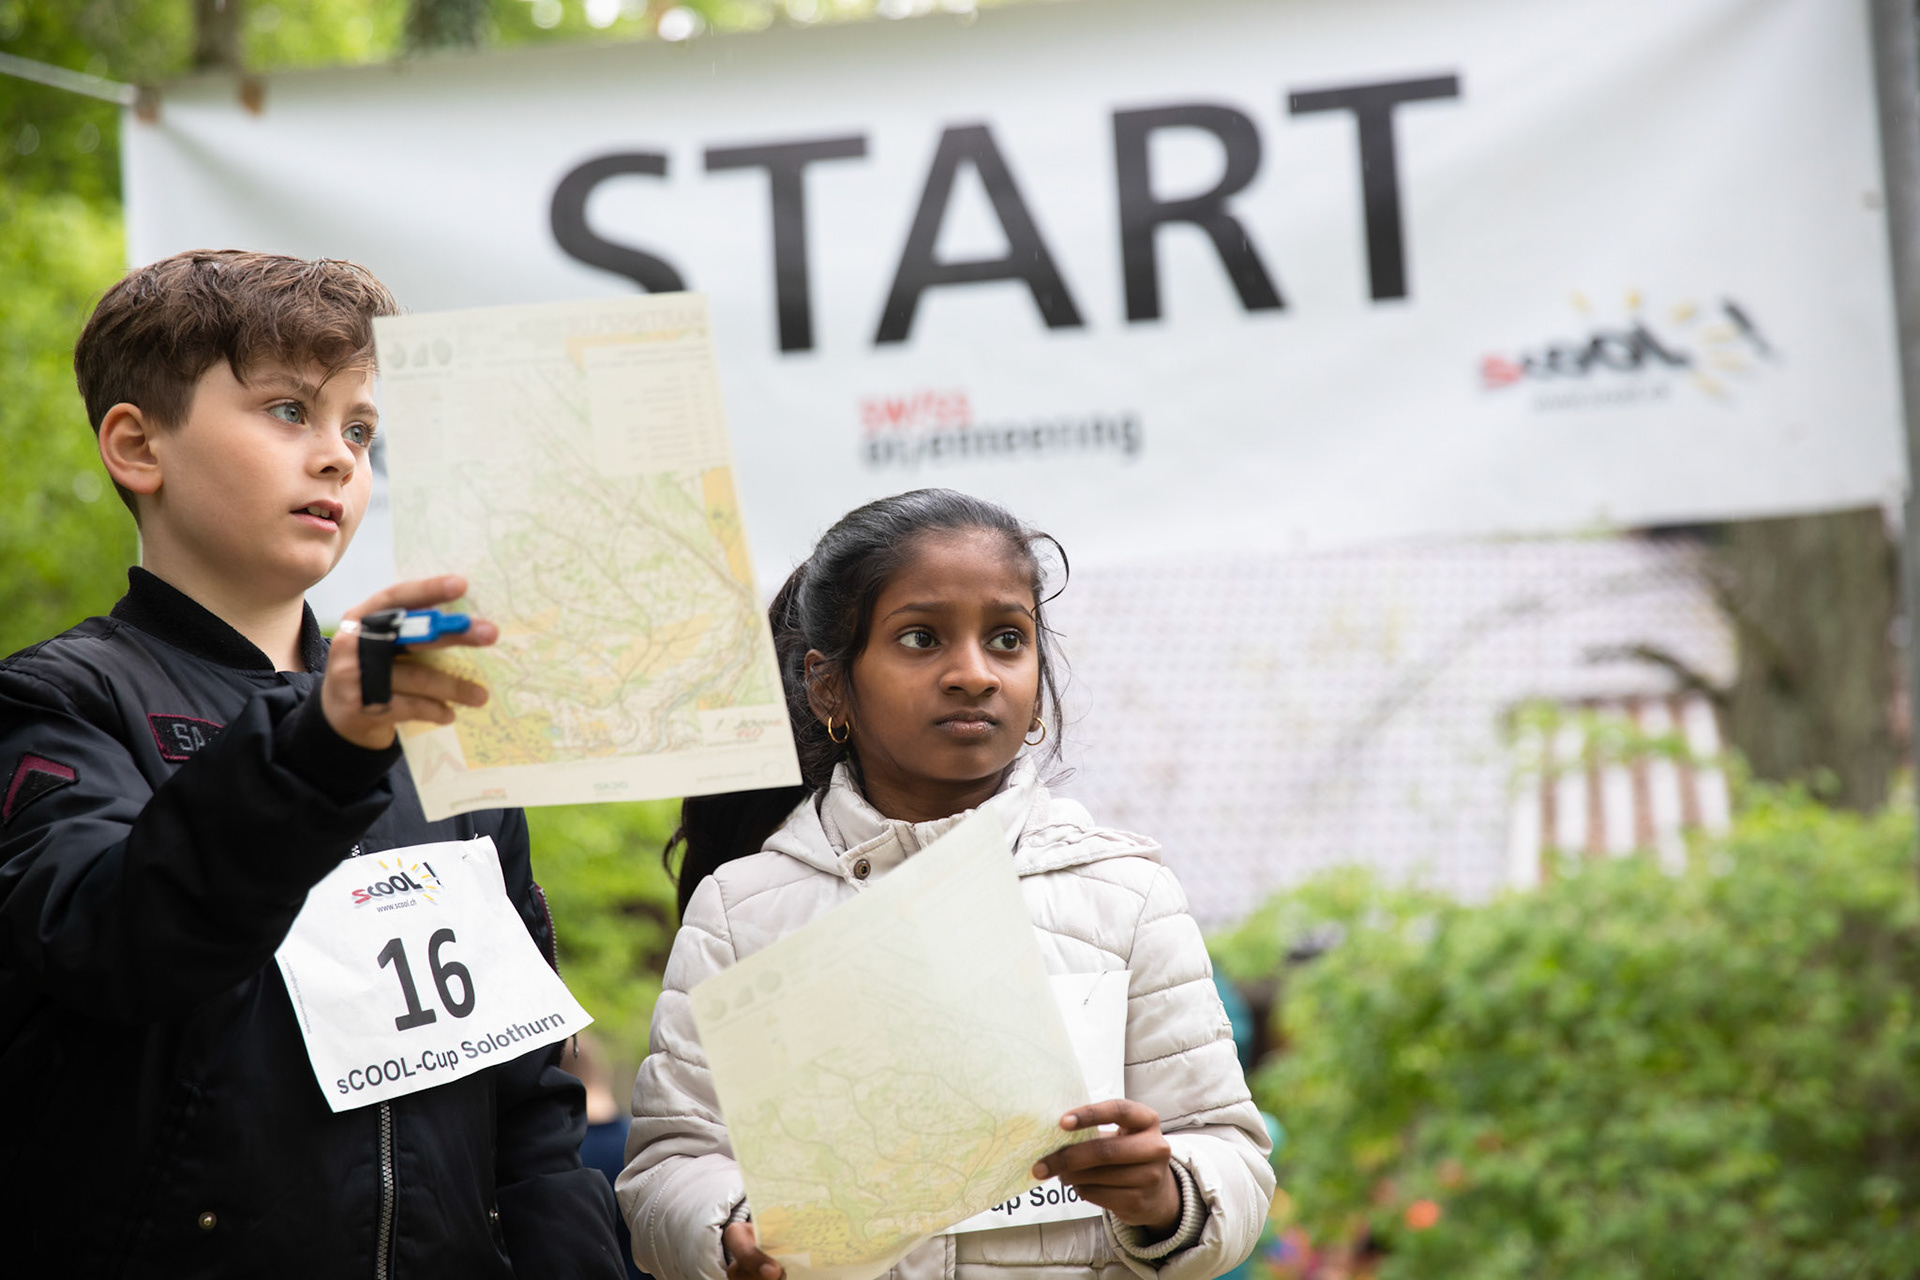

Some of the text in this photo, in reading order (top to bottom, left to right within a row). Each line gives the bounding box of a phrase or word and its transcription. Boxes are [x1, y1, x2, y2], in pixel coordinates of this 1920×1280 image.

[547, 73, 1461, 355] START
[376, 899, 417, 913] www.scool.ch
[376, 927, 476, 1032] 16
[336, 1012, 566, 1094] sCOOL-Cup Solothurn
